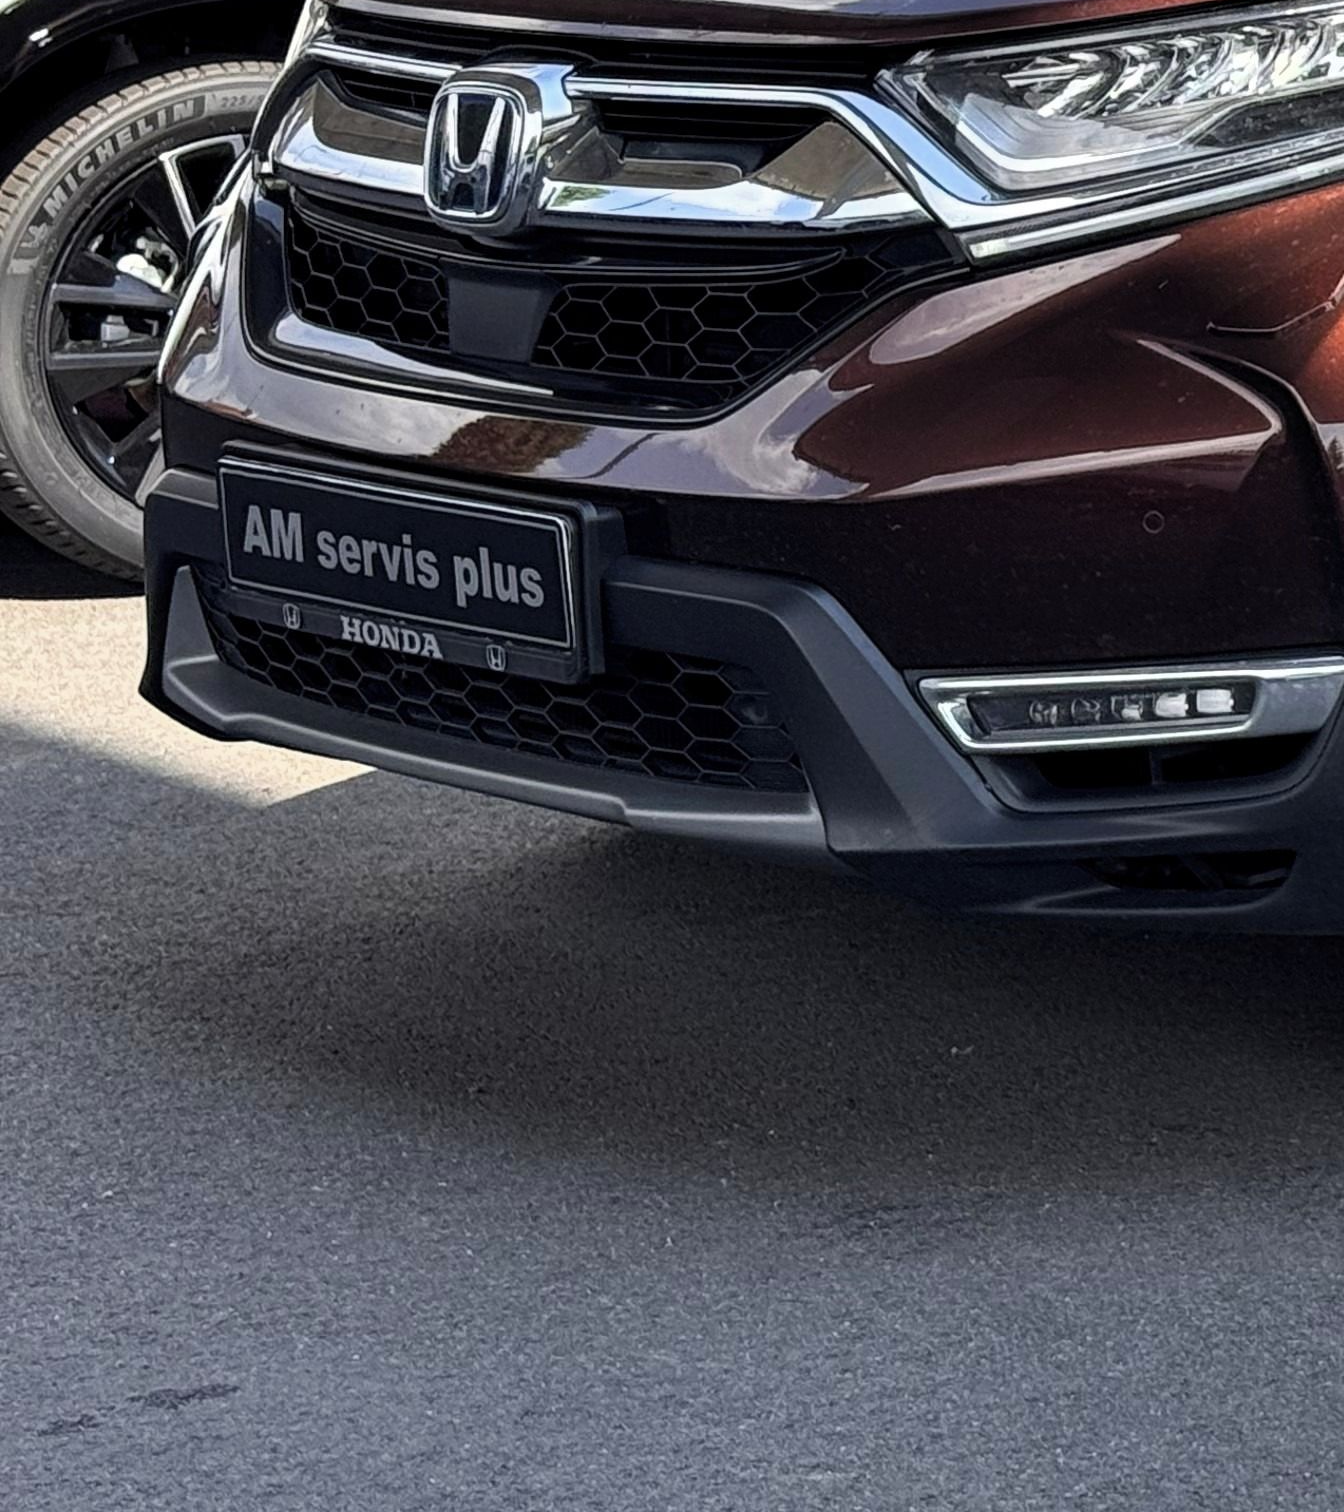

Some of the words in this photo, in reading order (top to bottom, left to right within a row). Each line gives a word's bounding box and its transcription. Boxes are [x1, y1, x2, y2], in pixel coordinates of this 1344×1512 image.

[43, 99, 195, 220] MICHELIN
[243, 504, 305, 563] AM
[315, 530, 441, 590] servis
[453, 546, 545, 609] plus
[340, 615, 444, 660] HONDA
